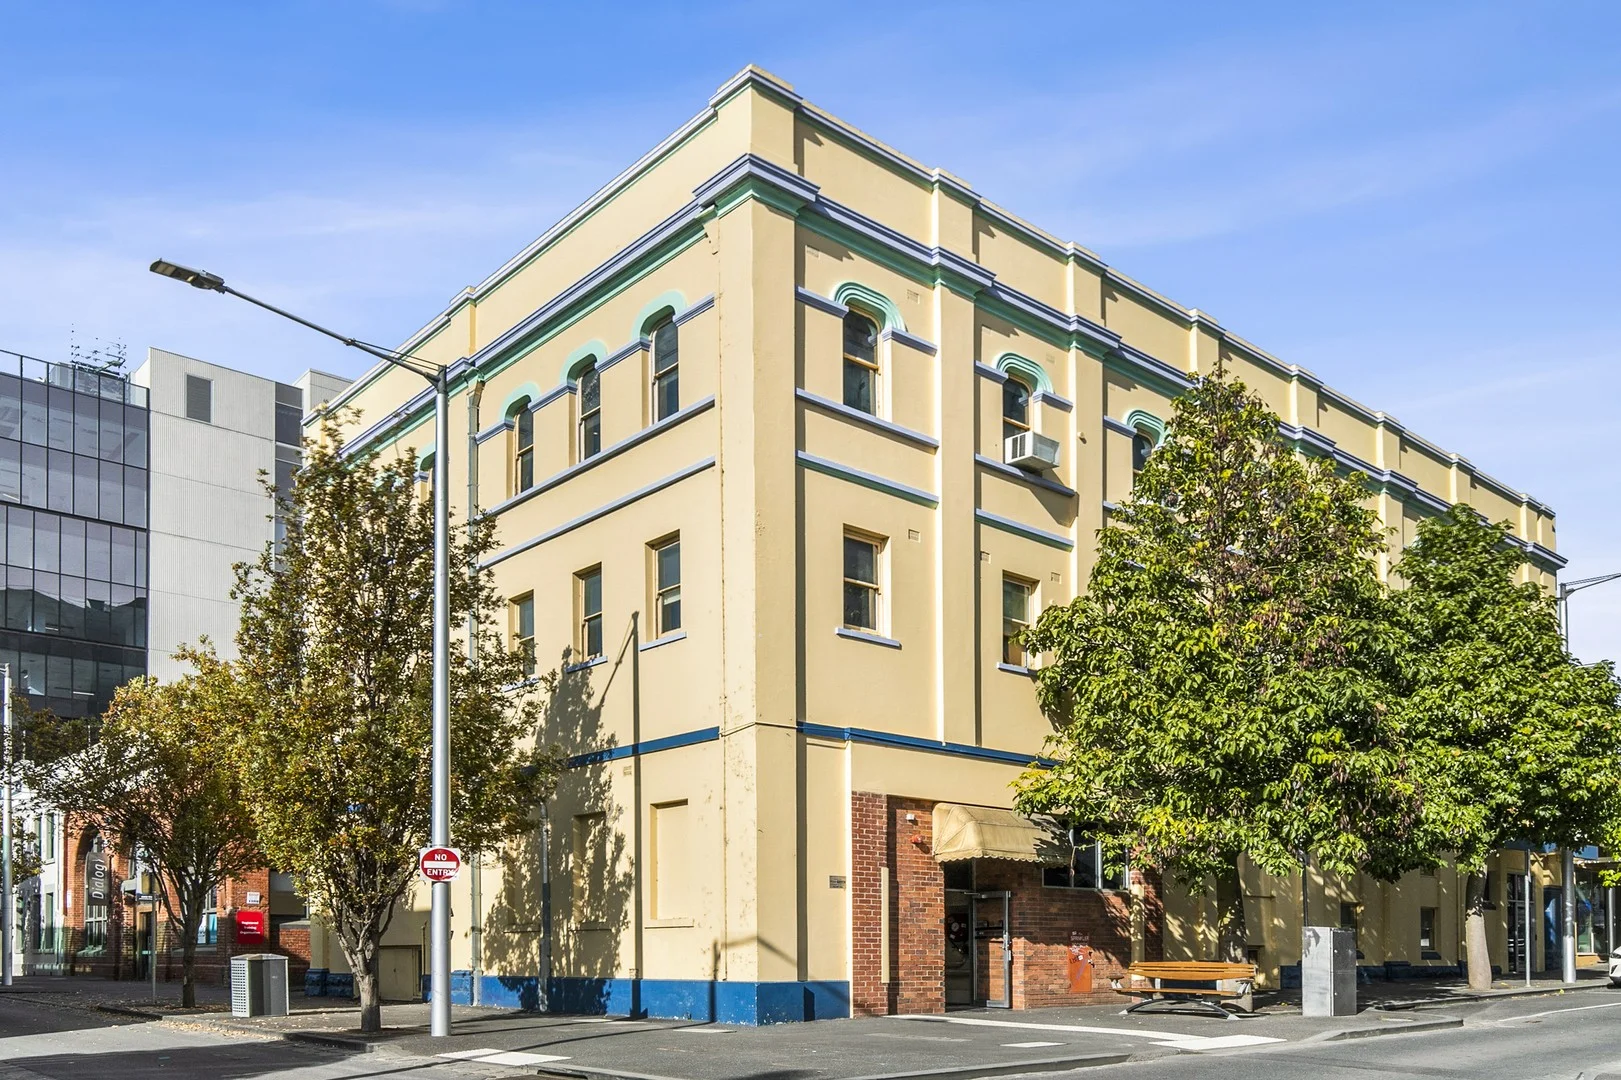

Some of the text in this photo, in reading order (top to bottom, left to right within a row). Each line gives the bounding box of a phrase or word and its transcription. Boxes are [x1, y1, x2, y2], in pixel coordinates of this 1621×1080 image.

[434, 853, 447, 861] NO
[426, 868, 455, 876] ENTRY
[91, 863, 108, 899] Dialog
